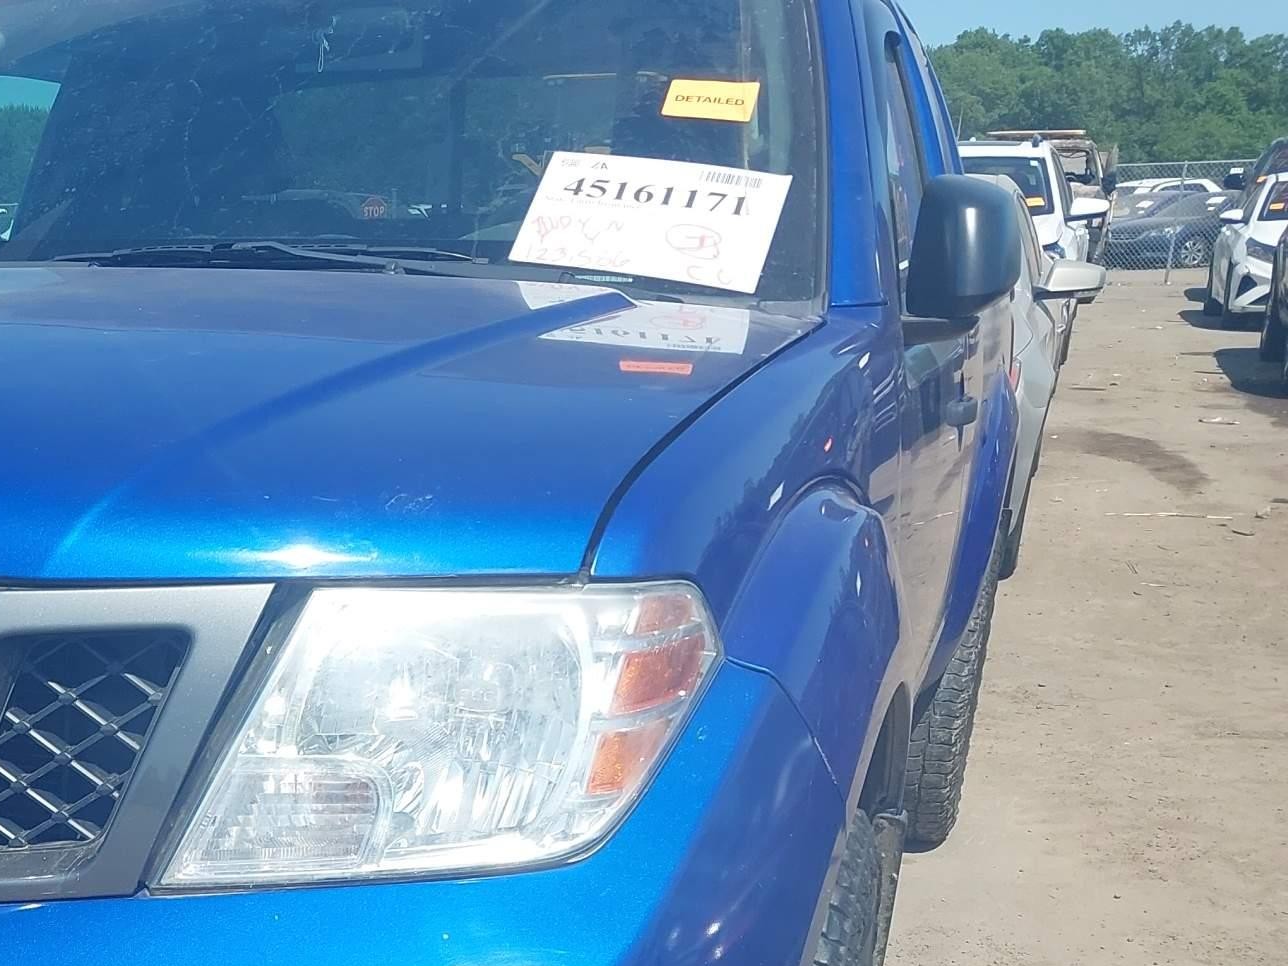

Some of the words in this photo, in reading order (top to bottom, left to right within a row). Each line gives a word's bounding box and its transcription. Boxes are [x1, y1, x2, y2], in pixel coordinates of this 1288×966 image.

[675, 94, 745, 106] DETAILED
[563, 177, 746, 215] 45161171
[364, 206, 385, 217] STOP
